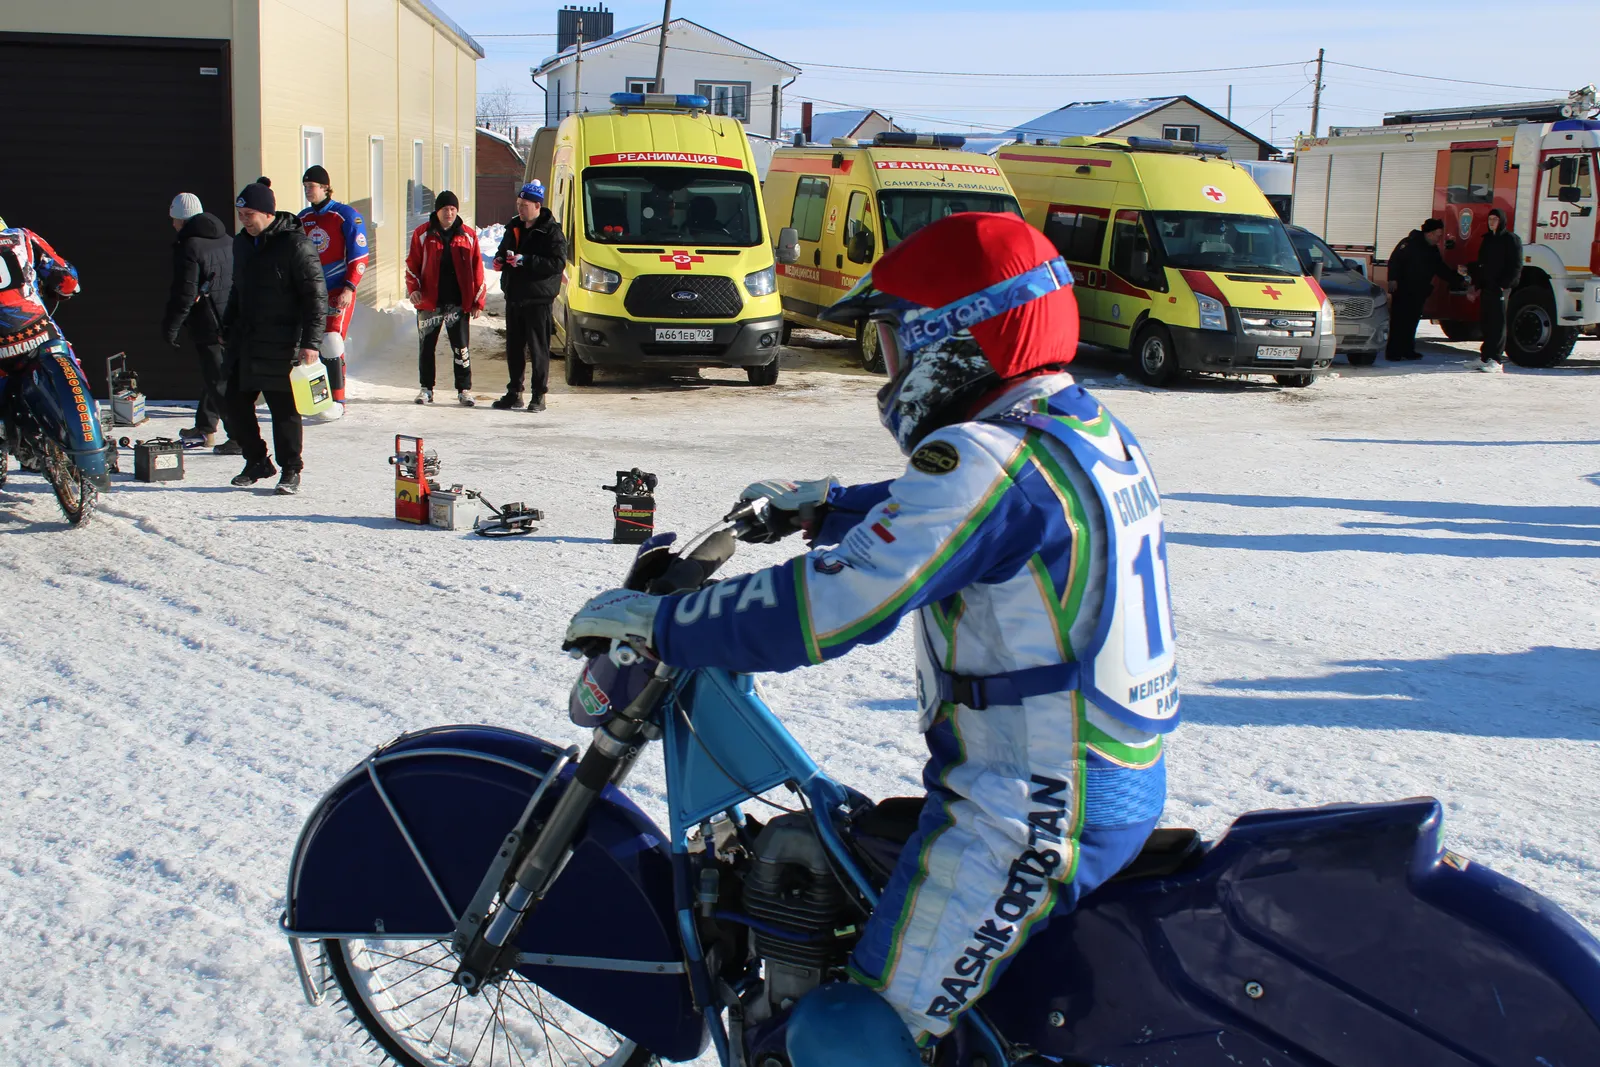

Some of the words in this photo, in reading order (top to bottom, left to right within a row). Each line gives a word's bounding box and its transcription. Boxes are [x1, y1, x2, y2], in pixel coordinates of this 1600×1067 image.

[616, 153, 718, 164] РЕАНИМАЦИЯ
[876, 161, 998, 175] РЕАНИМАЦИЯ
[884, 180, 955, 189] САНИТАРНАЯ
[957, 182, 1006, 193] АВИАЦИЯ
[1549, 210, 1570, 228] 50
[1543, 232, 1571, 241] МЕЛЕУЗ
[784, 263, 820, 282] МЕДИЦИНСКАЯ
[900, 296, 998, 349] VECTOR
[0, 332, 49, 360] MAKAROV
[674, 567, 778, 626] UFA
